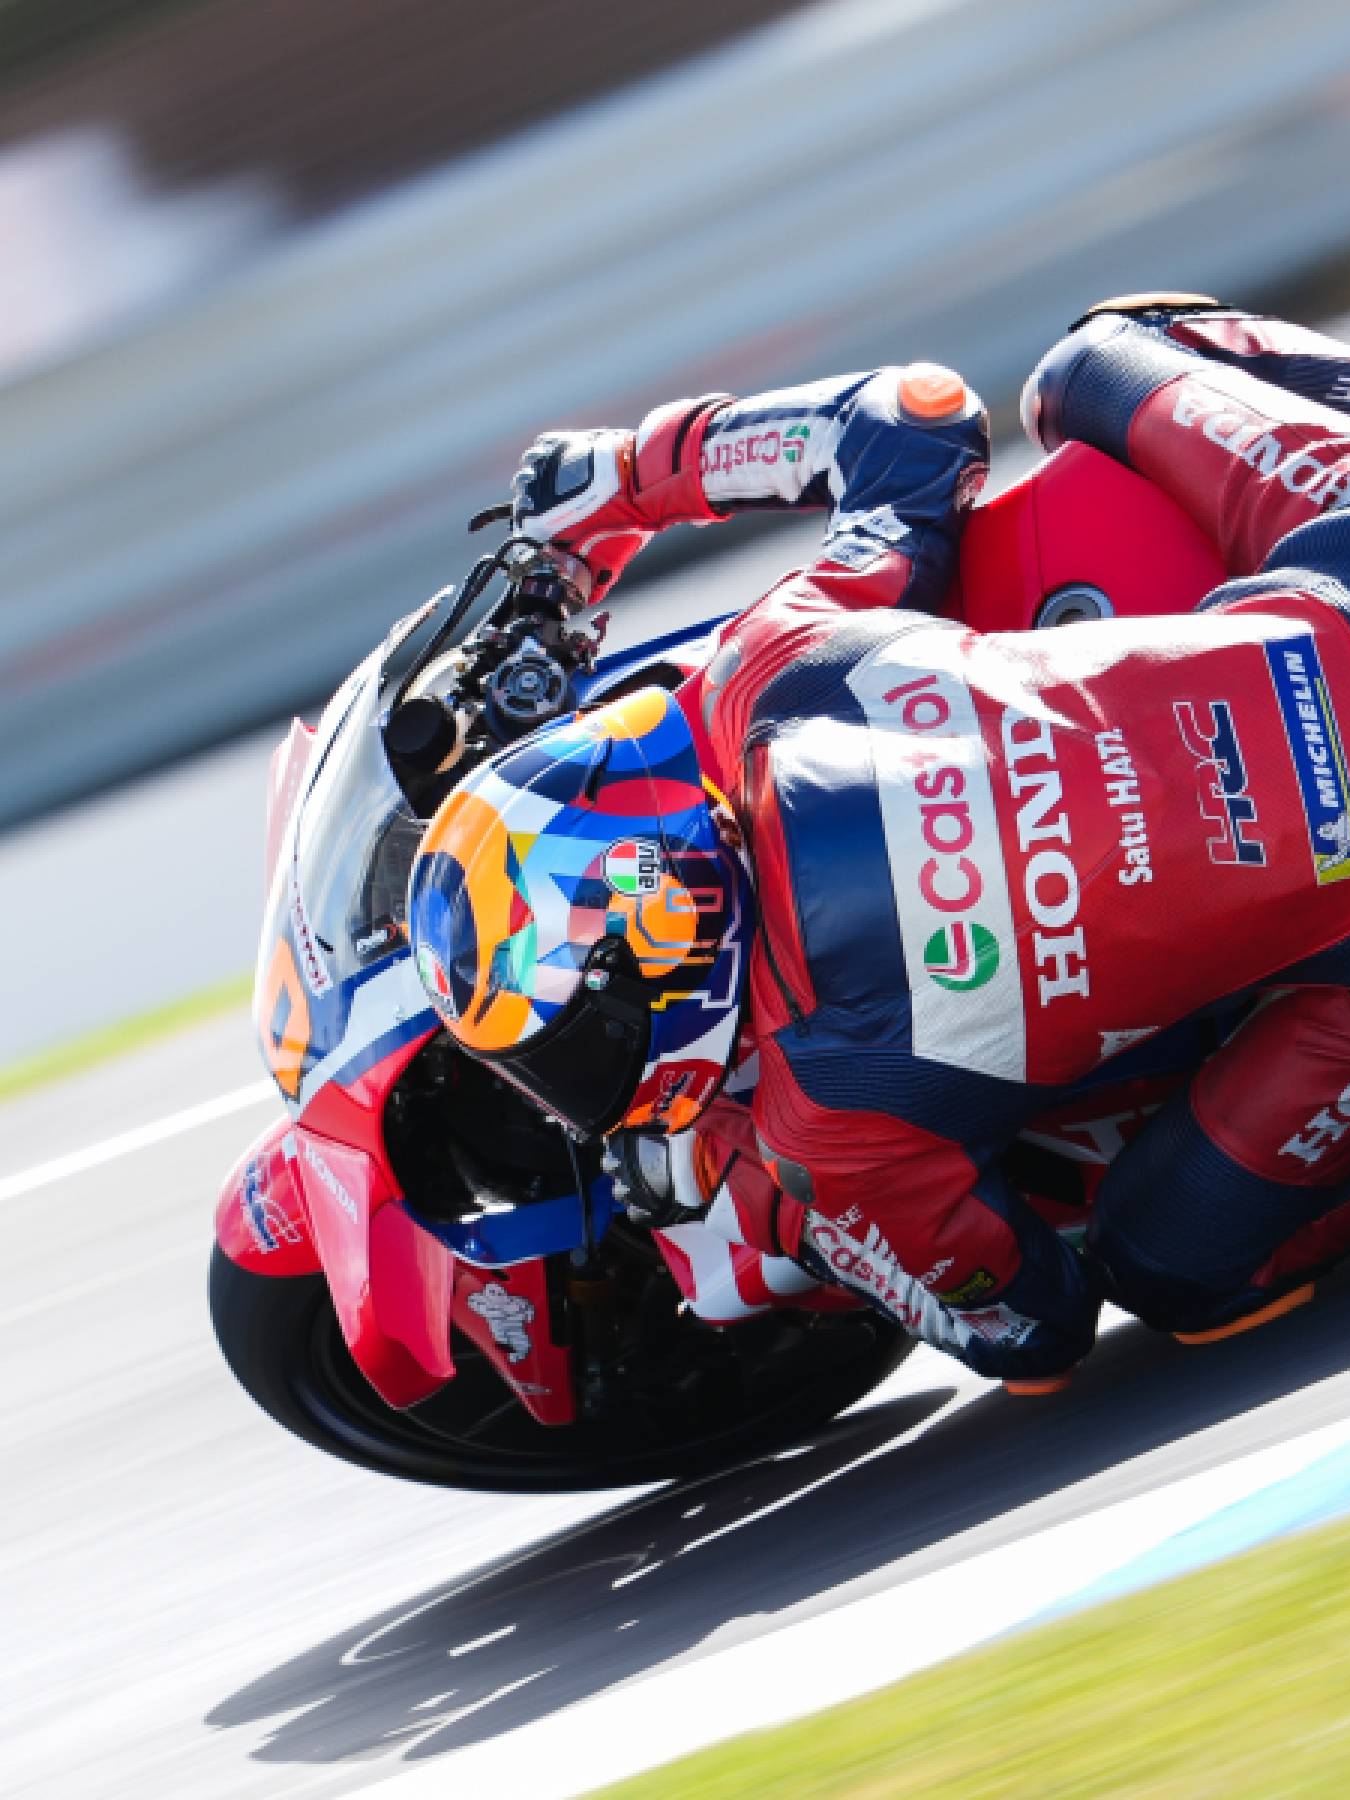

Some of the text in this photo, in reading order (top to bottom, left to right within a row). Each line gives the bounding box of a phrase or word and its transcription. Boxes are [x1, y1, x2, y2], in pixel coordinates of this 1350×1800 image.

[700, 431, 781, 476] Castro
[883, 674, 985, 913] Casol
[1284, 652, 1339, 808] MICHELIN
[1002, 708, 1090, 1008] HOND
[1118, 808, 1152, 886] Satu
